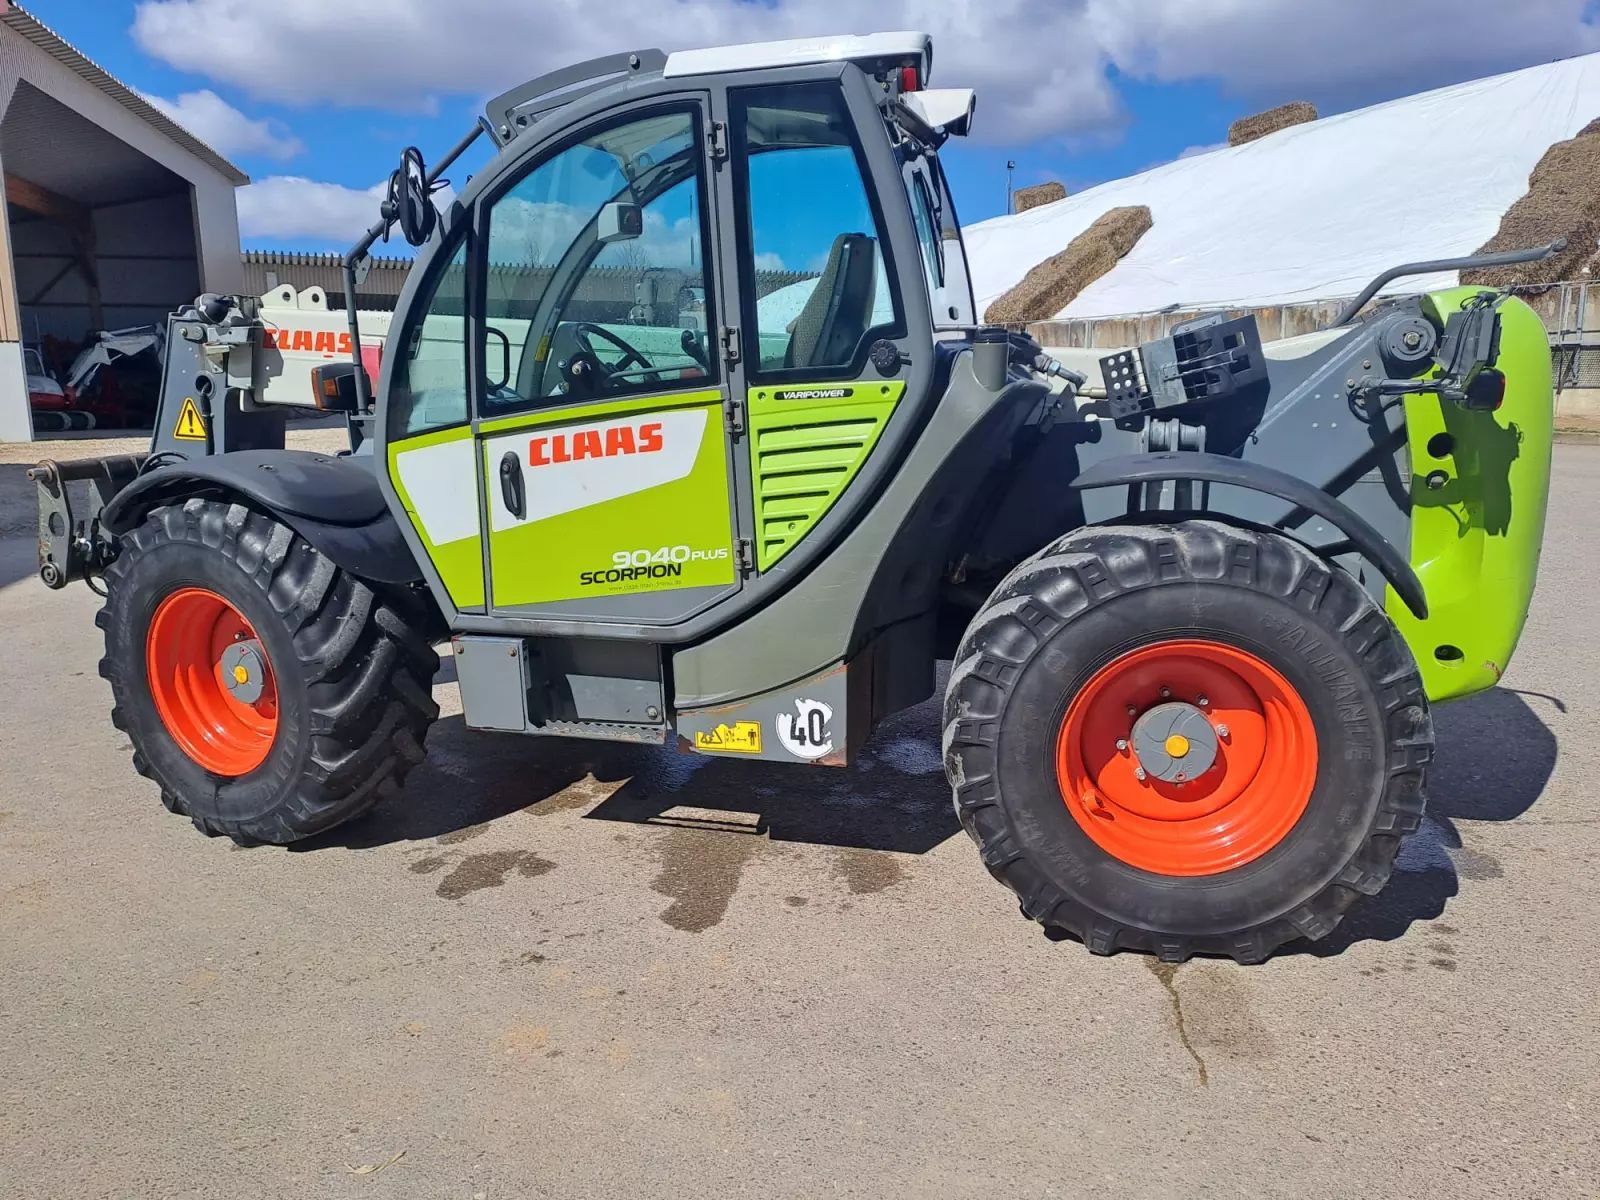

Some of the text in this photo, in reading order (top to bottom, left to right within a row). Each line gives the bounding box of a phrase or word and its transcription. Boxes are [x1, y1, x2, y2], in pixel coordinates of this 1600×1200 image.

[263, 328, 353, 353] CLAAS
[783, 389, 845, 399] VARIPOWER
[529, 422, 663, 467] CLAAS
[612, 545, 728, 569] 9040 PLUS
[580, 563, 682, 585] SCORPION
[790, 708, 825, 747] 40
